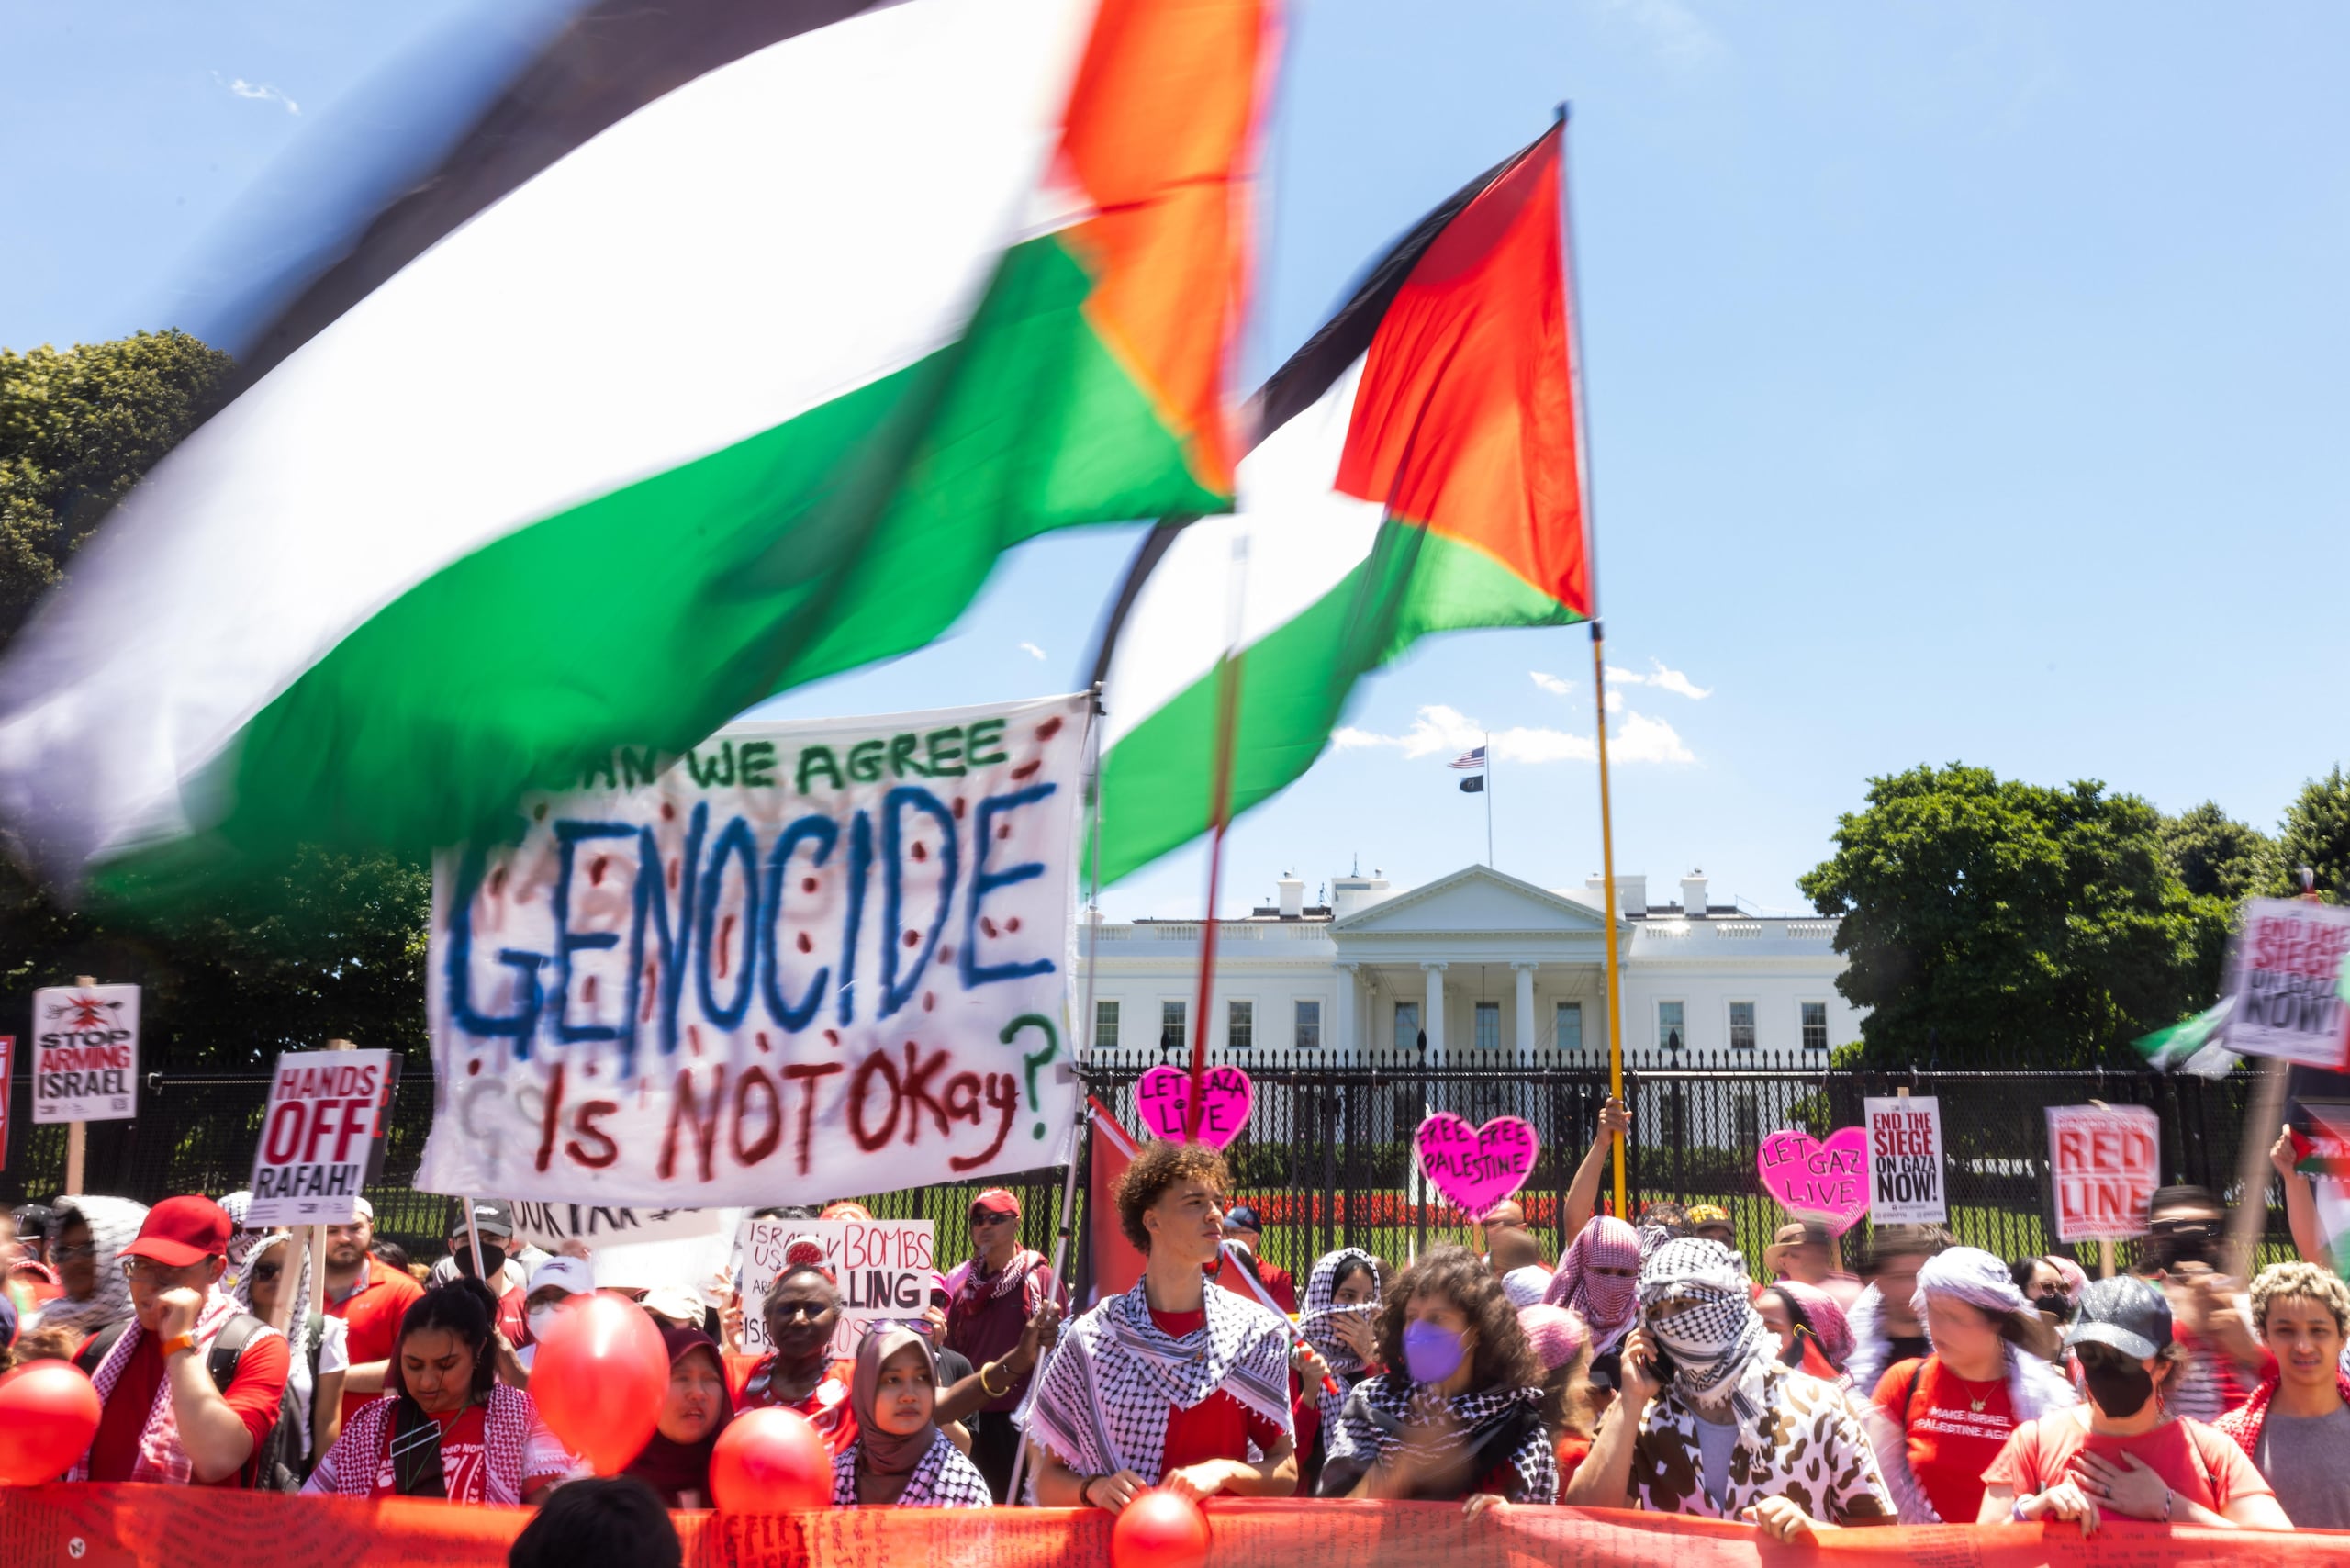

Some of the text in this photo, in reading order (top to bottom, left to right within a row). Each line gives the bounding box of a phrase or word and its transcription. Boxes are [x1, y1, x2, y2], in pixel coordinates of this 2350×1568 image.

[686, 740, 776, 790] WE
[796, 718, 1008, 796] AGREE
[446, 781, 1058, 1077] GENOCIDE
[40, 1030, 130, 1048] STOP
[39, 1046, 131, 1073] ARMING
[39, 1070, 131, 1099] ISRAEL
[276, 1065, 378, 1100] HANDS
[1141, 1073, 1186, 1099] LET
[264, 1099, 373, 1165] OFF
[655, 1059, 844, 1182] NOT
[1417, 1118, 1528, 1154] FREE FREE
[1874, 1111, 1931, 1130] END THE
[1762, 1137, 1870, 1175] LET GAZ
[1874, 1128, 1934, 1157] SIEGE
[2060, 1130, 2155, 1174] RED
[1423, 1150, 1527, 1186] PALESTINE
[1875, 1155, 1936, 1174] ON GAZA
[254, 1165, 360, 1199] RAFAH!
[1785, 1179, 1858, 1204] LIVE
[1877, 1172, 1938, 1203] NOW!
[2061, 1177, 2150, 1224] LINE
[844, 1224, 933, 1271] BOMBS
[1914, 1418, 2010, 1440] PALESTINE AGA
[1928, 1406, 2009, 1426] MAKE ISRAEL
